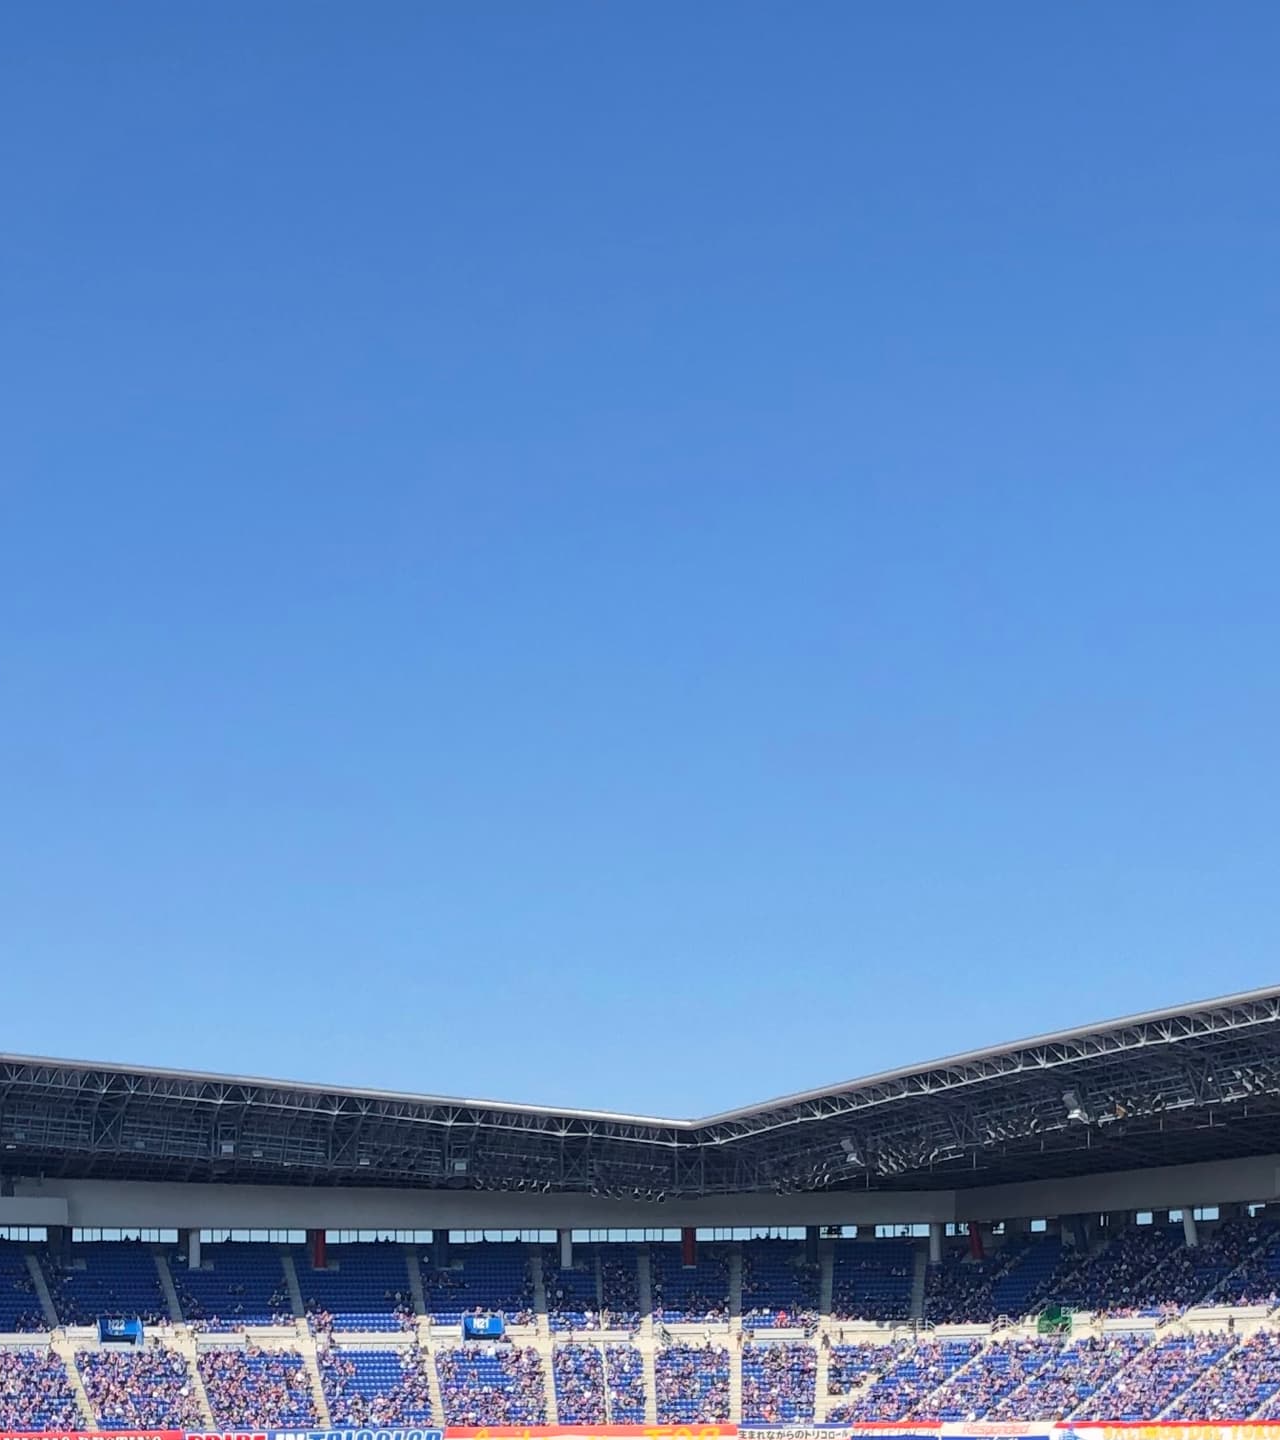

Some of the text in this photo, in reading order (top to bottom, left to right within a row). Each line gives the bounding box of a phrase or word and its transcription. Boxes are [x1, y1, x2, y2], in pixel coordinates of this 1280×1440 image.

[738, 1429, 848, 1440] 生まれながらのトリコロール
